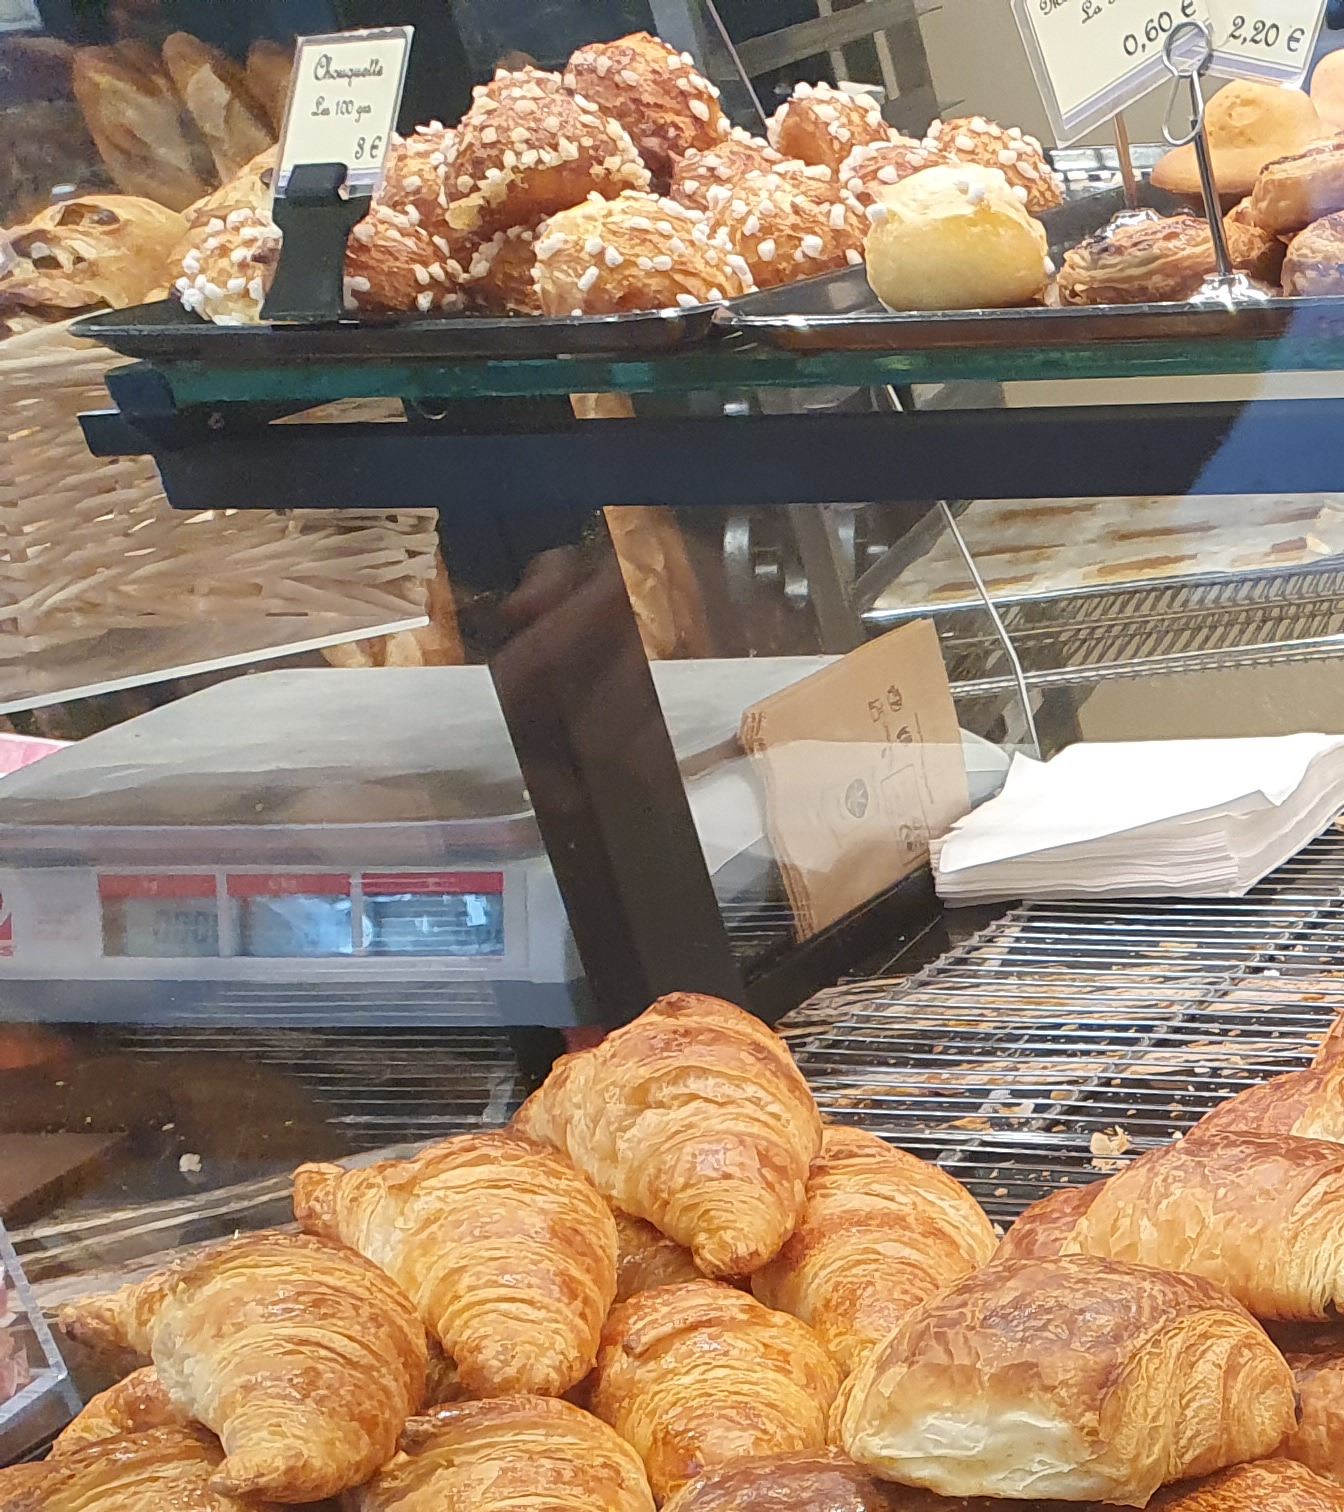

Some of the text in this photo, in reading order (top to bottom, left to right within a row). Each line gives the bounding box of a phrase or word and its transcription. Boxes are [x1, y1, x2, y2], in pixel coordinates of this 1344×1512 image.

[1123, 11, 1173, 56] 0,60
[1228, 15, 1306, 52] 2,20 €
[370, 135, 383, 159] €
